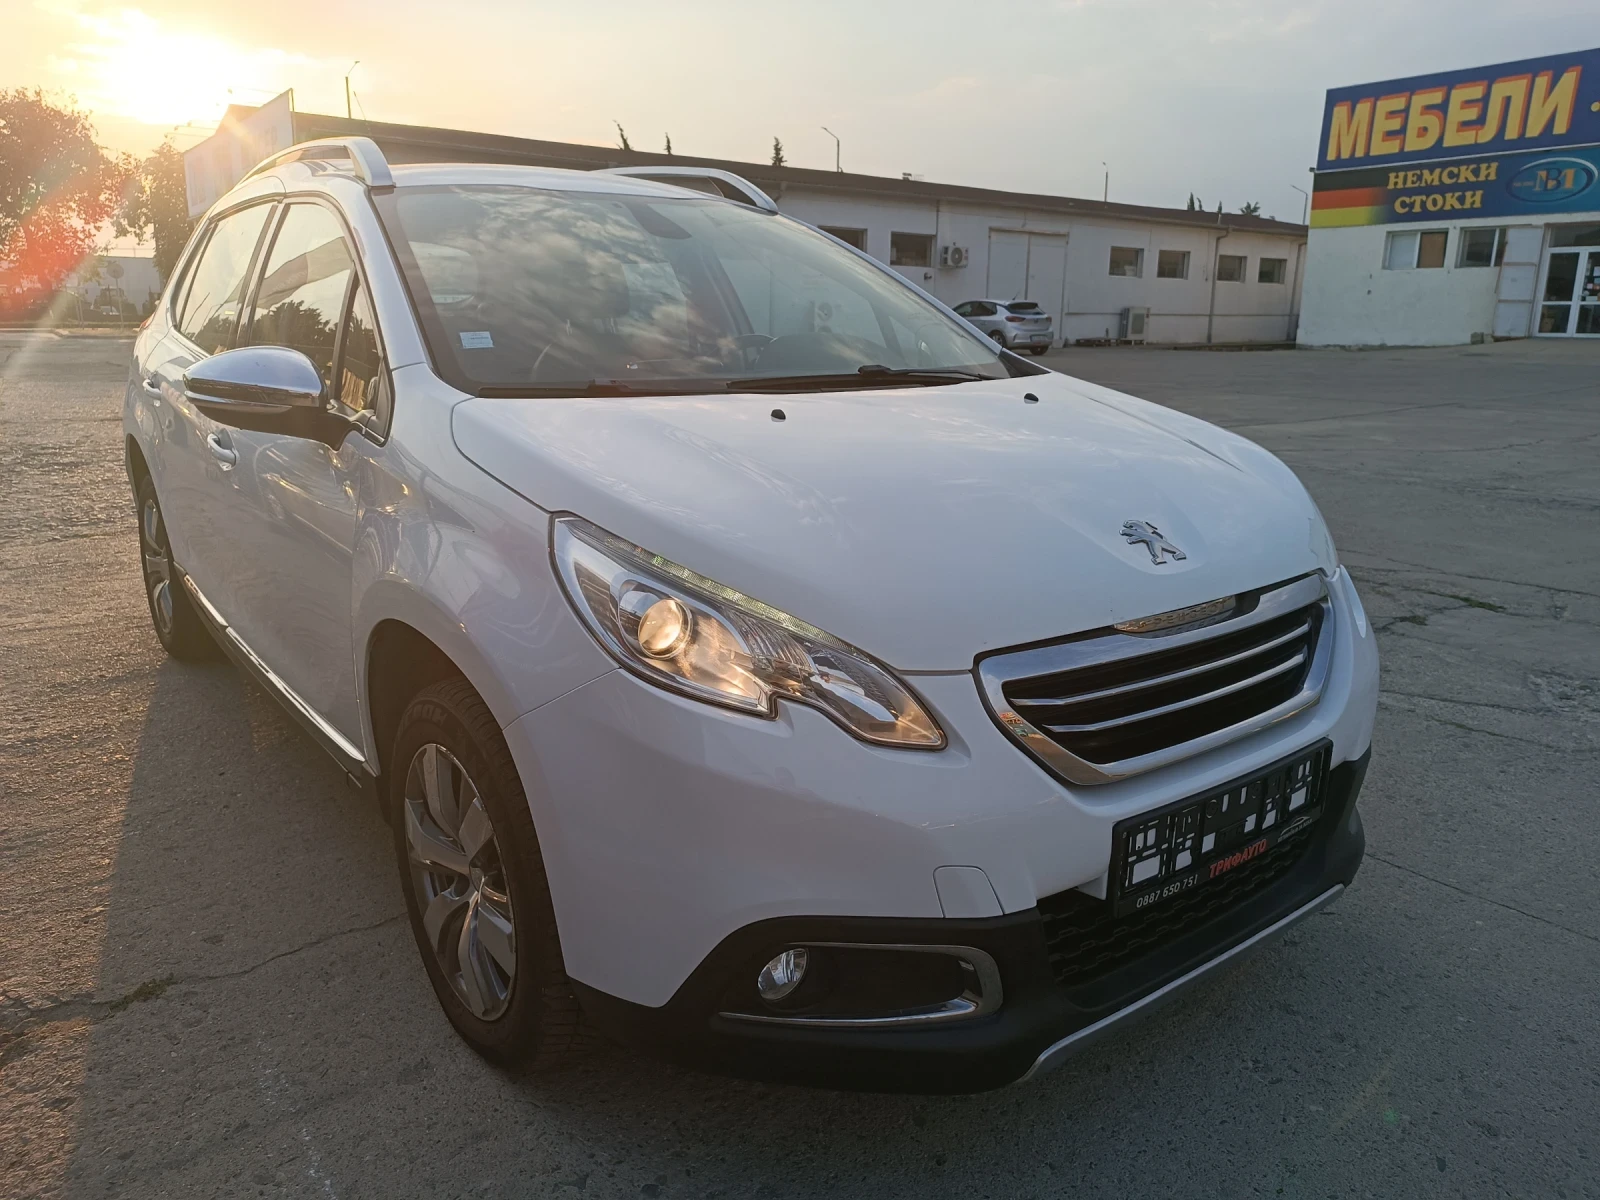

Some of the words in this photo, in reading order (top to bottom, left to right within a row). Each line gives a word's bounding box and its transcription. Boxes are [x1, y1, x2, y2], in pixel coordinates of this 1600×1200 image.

[1326, 65, 1583, 161] МЕБЕЛИ
[1386, 162, 1499, 189] НЕМСКИ
[1394, 190, 1484, 214] СТОКИ
[1209, 838, 1267, 879] ТРИФАУТО
[1136, 889, 1161, 908] 0887
[1162, 882, 1181, 898] 650
[1182, 873, 1199, 890] 751
